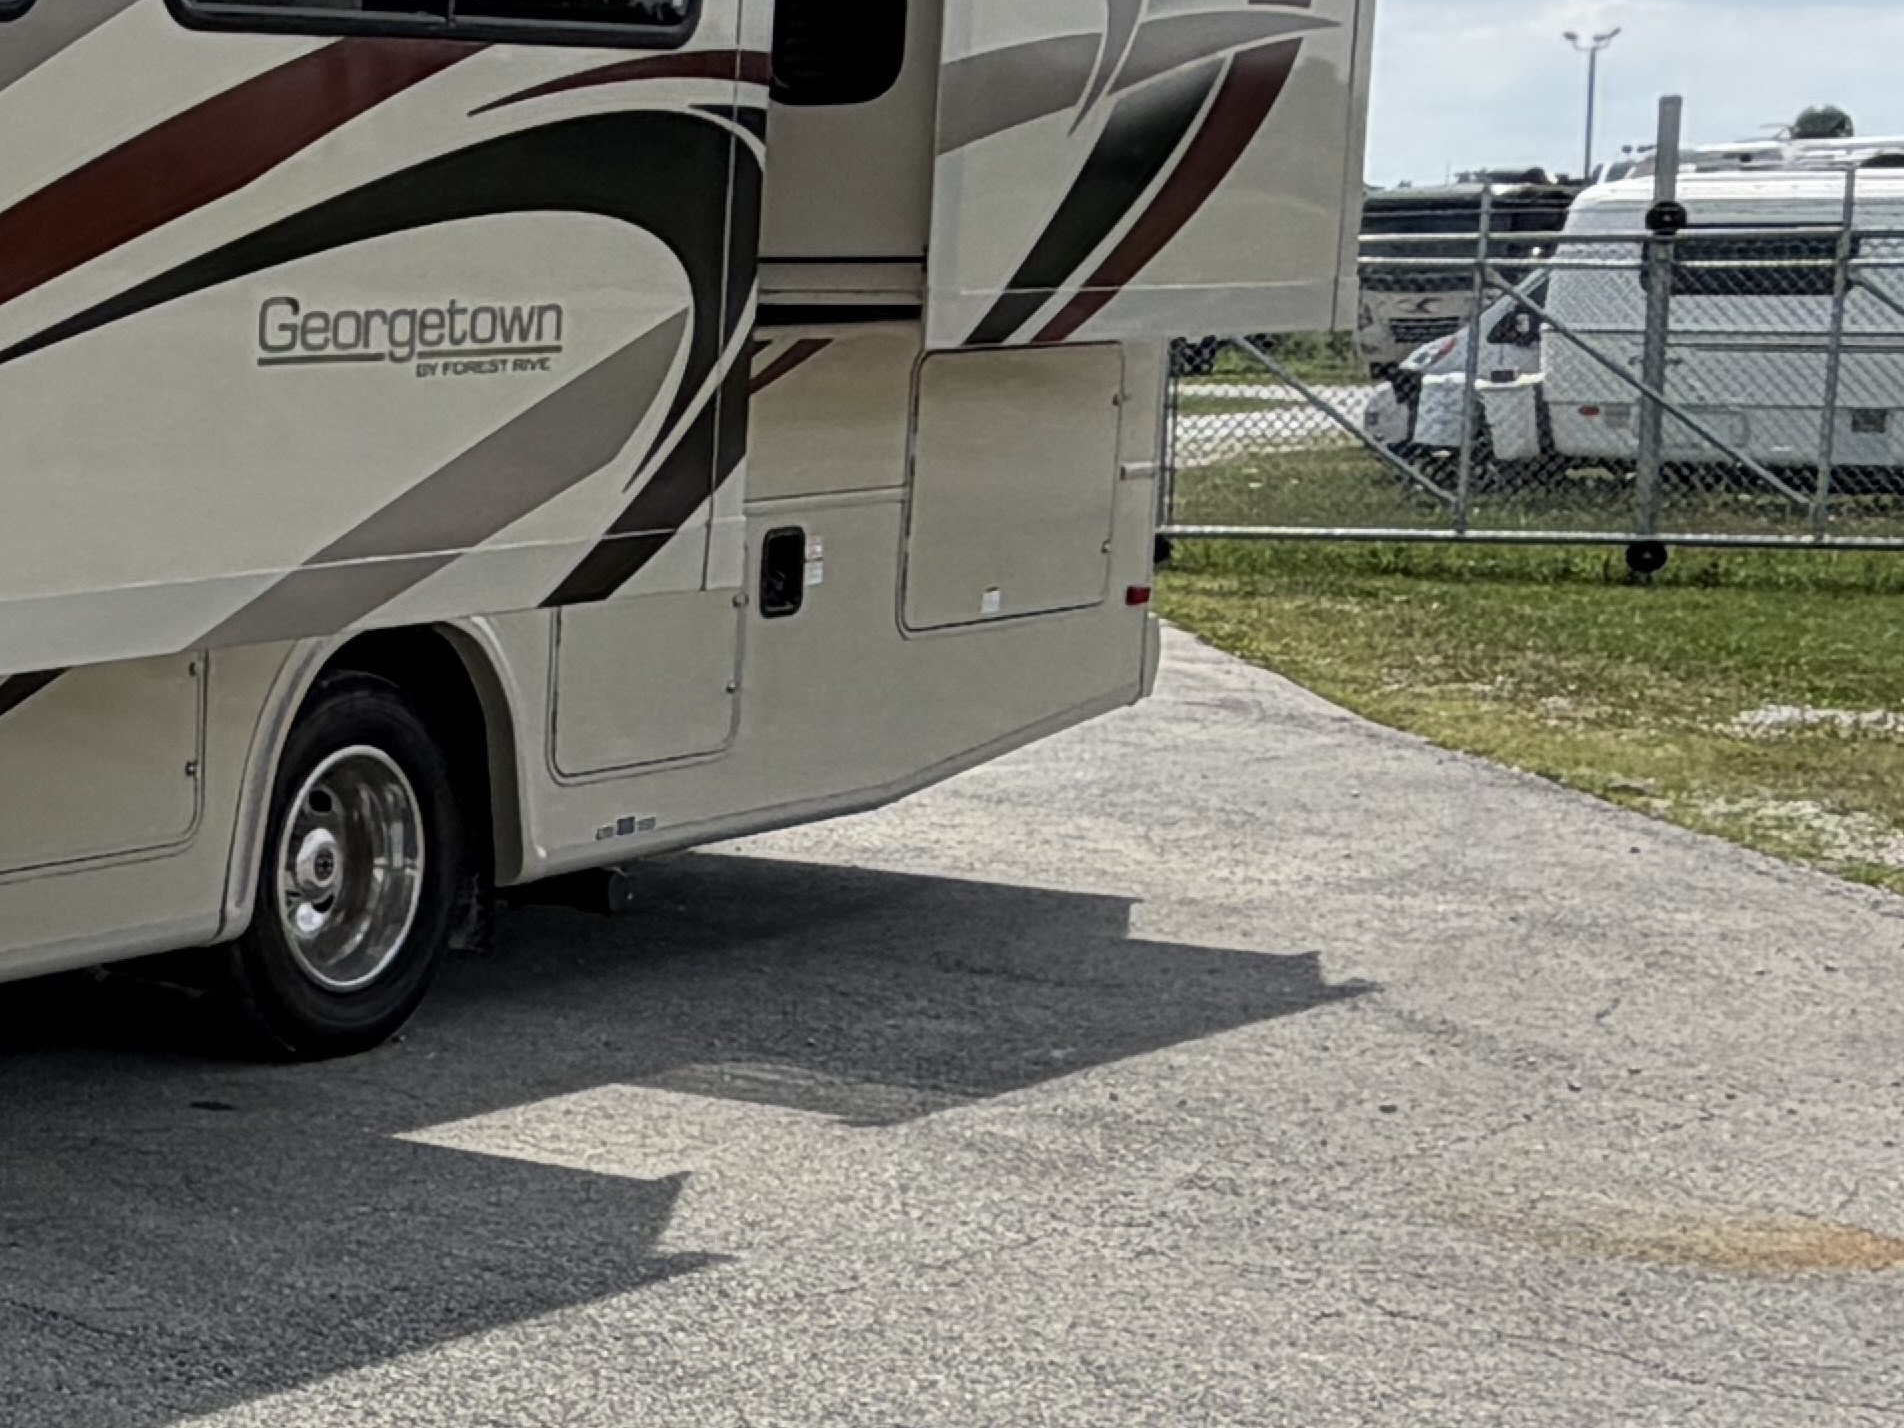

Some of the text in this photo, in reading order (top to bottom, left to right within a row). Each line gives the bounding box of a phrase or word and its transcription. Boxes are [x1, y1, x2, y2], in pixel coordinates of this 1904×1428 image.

[258, 295, 564, 364] Georgetown
[415, 362, 439, 378] BY
[442, 358, 509, 377] FOREST
